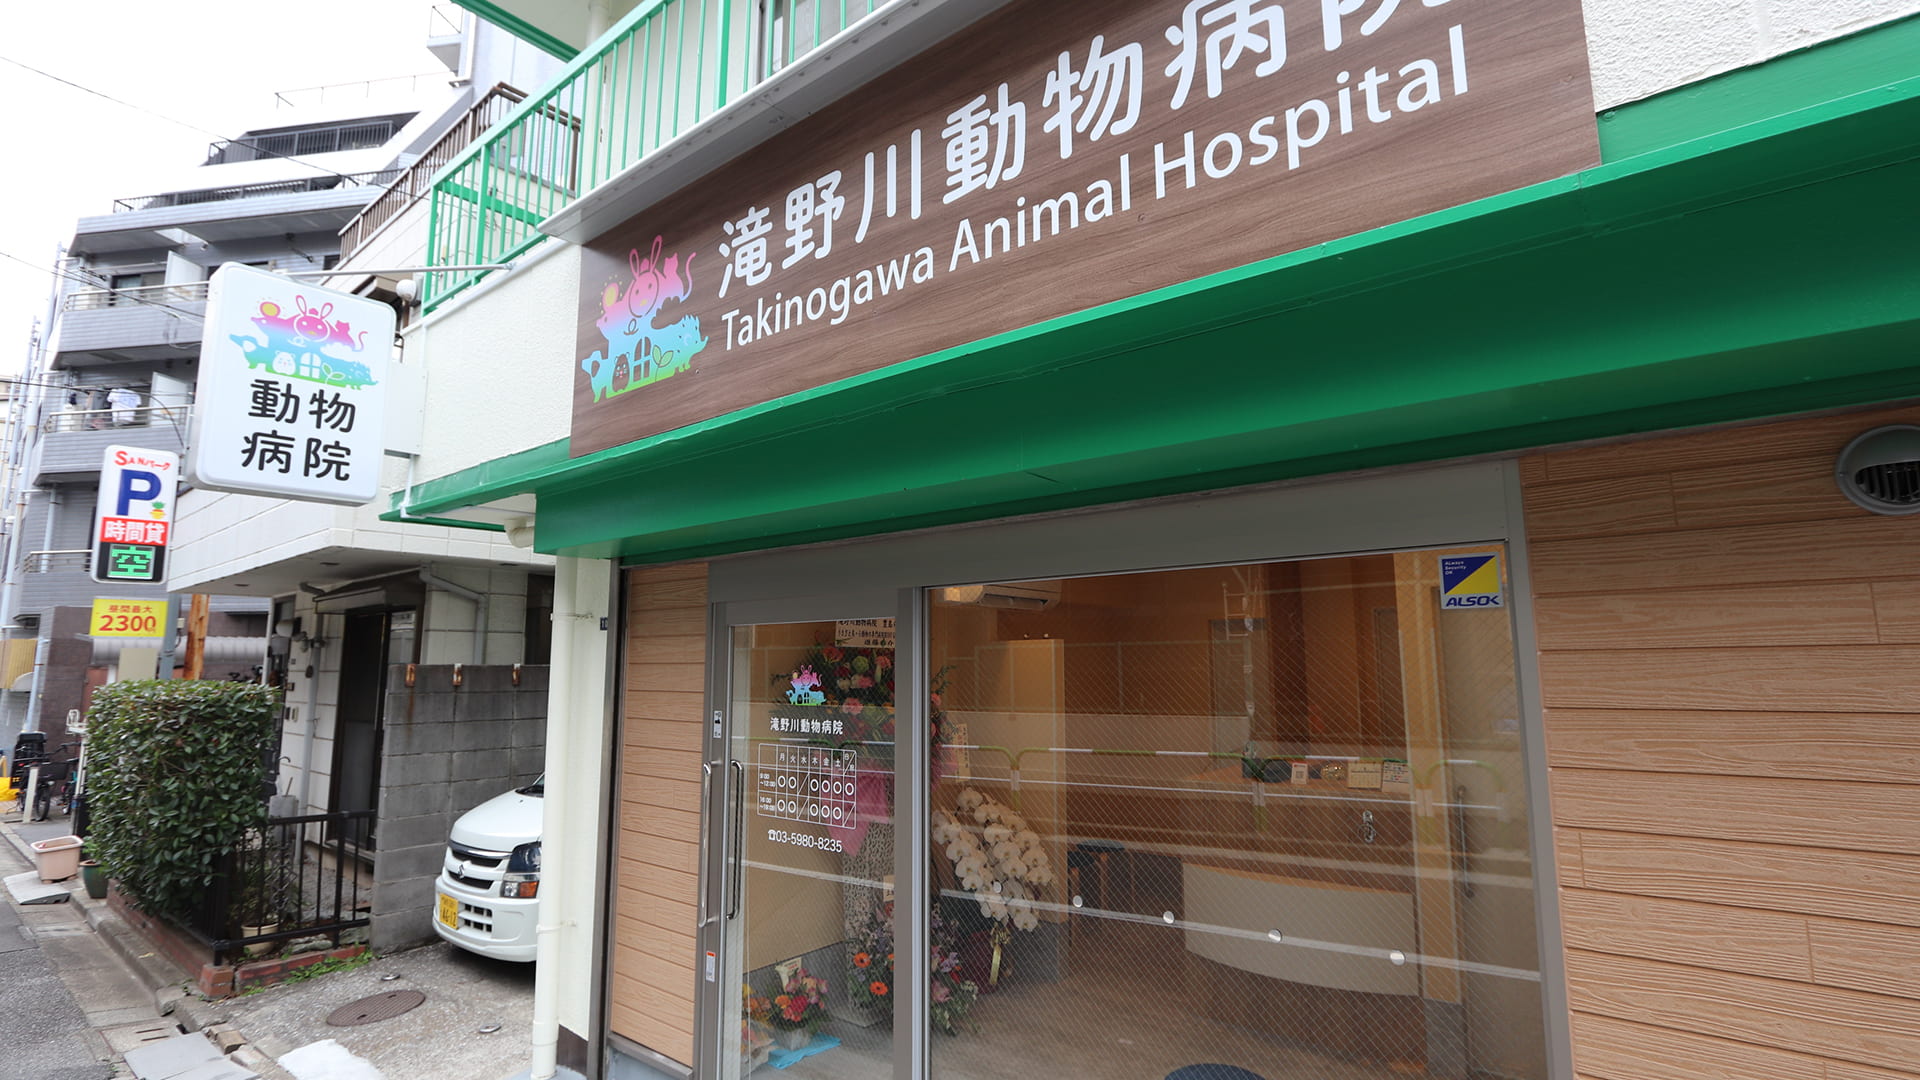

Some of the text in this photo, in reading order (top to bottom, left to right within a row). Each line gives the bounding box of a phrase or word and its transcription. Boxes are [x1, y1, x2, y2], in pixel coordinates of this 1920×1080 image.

[722, 24, 1470, 351] Takinogawa Animal Hospital
[248, 378, 356, 433] 動物
[241, 429, 351, 482] 病院
[116, 468, 162, 516] P
[104, 520, 166, 544] 時間貸
[108, 546, 153, 577] 空
[1446, 595, 1500, 607] ALSOK
[770, 717, 843, 735] 滝野川動物病院
[776, 830, 843, 853] 03-5980-8235
